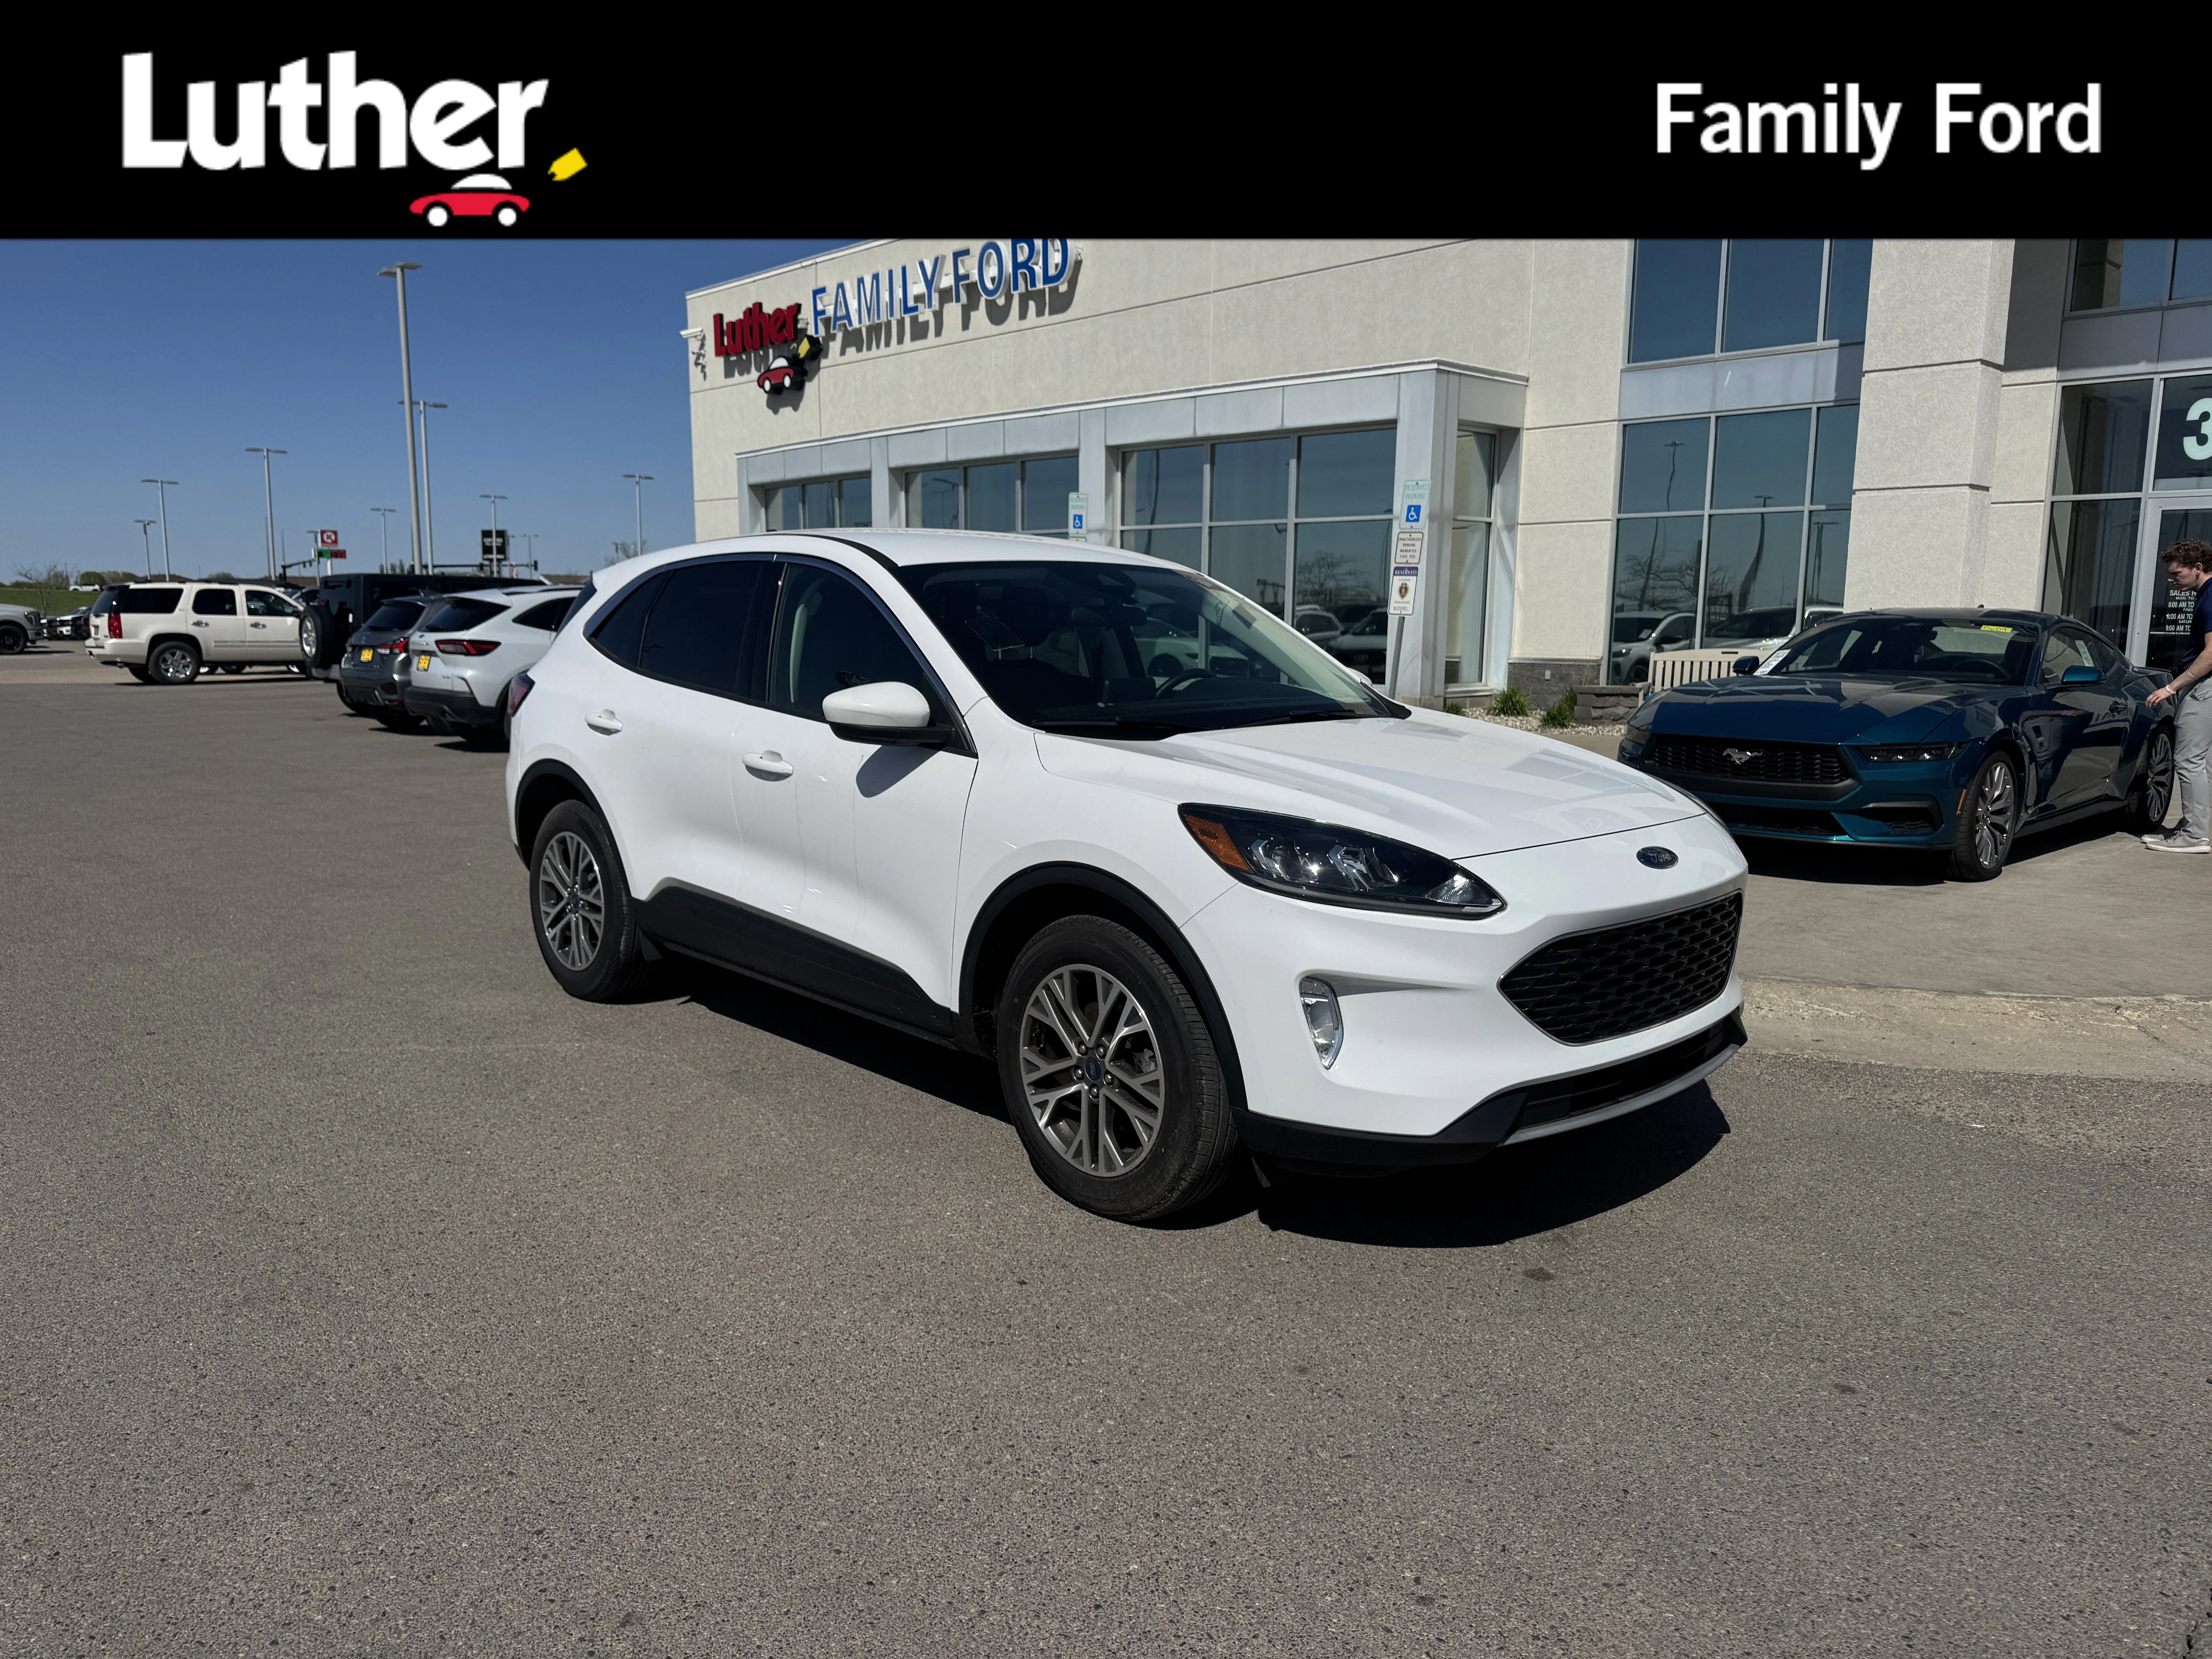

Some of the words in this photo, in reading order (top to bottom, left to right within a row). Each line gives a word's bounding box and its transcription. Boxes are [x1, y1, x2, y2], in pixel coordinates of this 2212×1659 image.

[812, 254, 943, 336] FAMILY
[951, 238, 1072, 303] FORD
[713, 302, 801, 357] Luther
